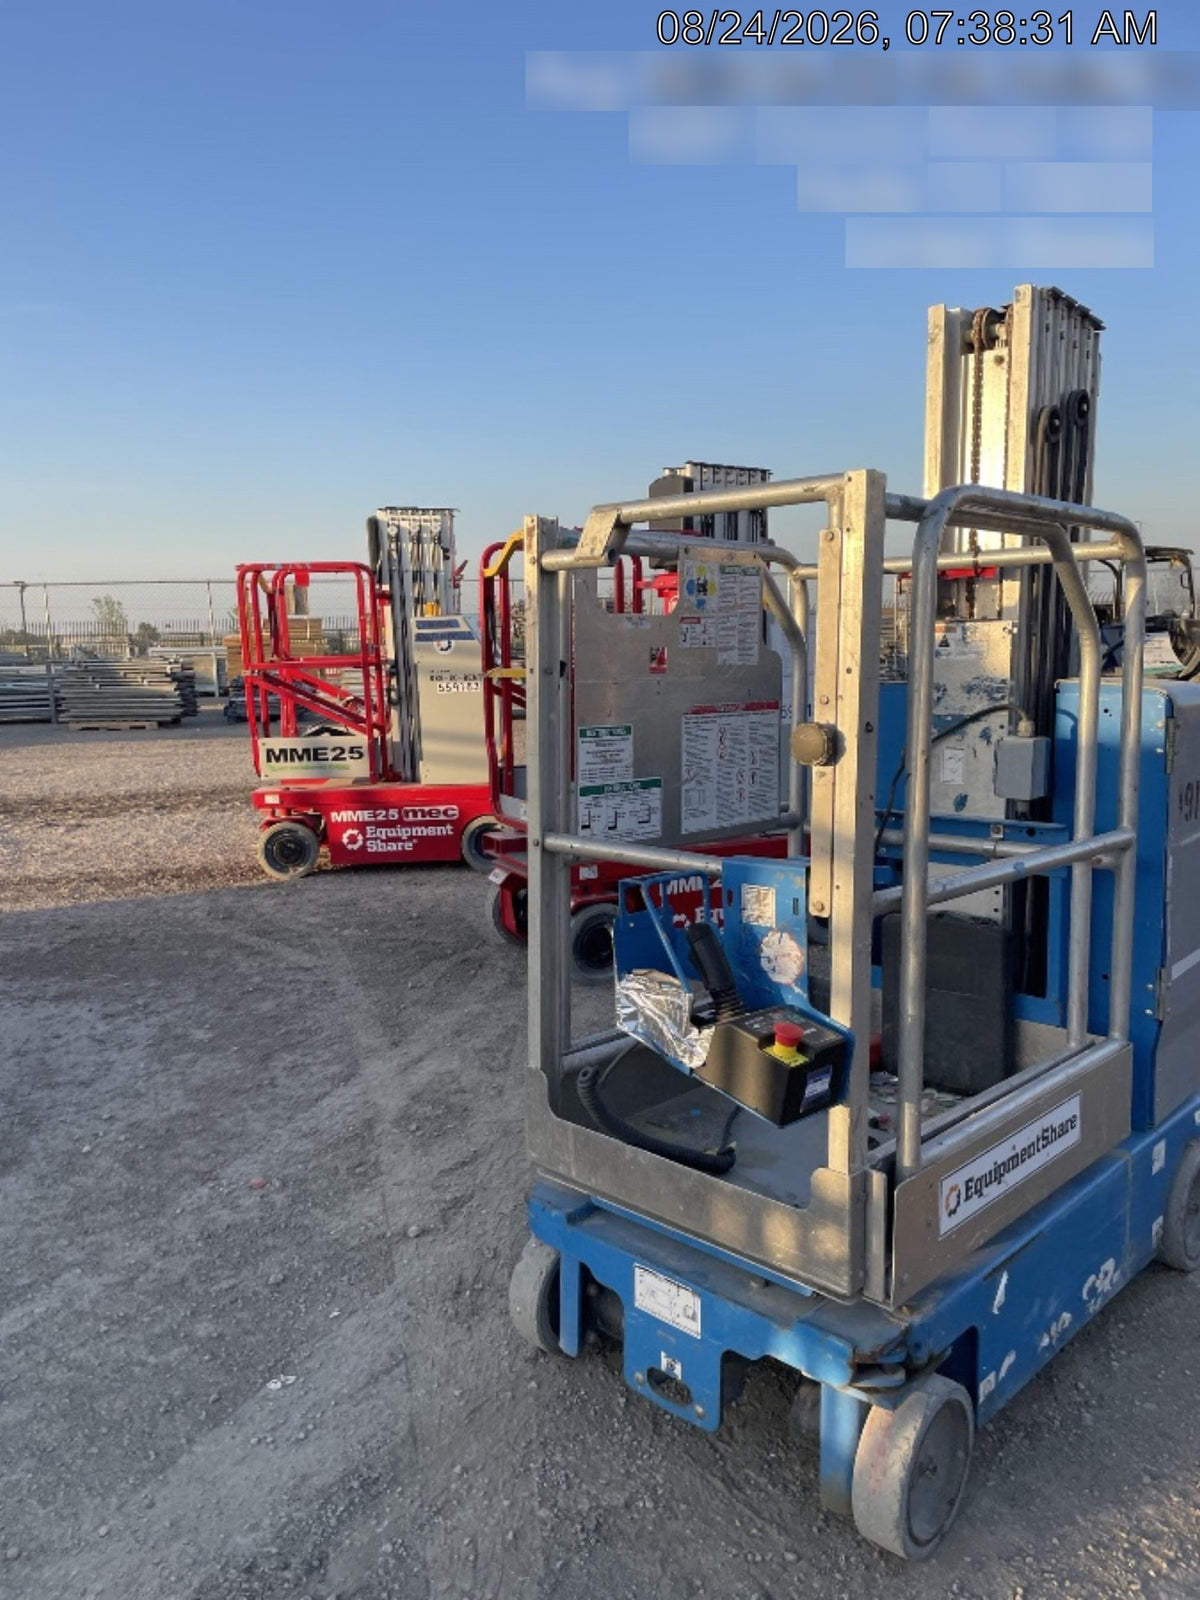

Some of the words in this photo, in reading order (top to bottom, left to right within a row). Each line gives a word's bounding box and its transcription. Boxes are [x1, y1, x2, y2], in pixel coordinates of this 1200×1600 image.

[266, 746, 364, 763] MME25
[330, 808, 399, 823] MME25
[403, 806, 458, 820] mec
[366, 824, 454, 840] Equipment
[367, 839, 414, 852] Share
[963, 1114, 1078, 1202] EquipmentShare
